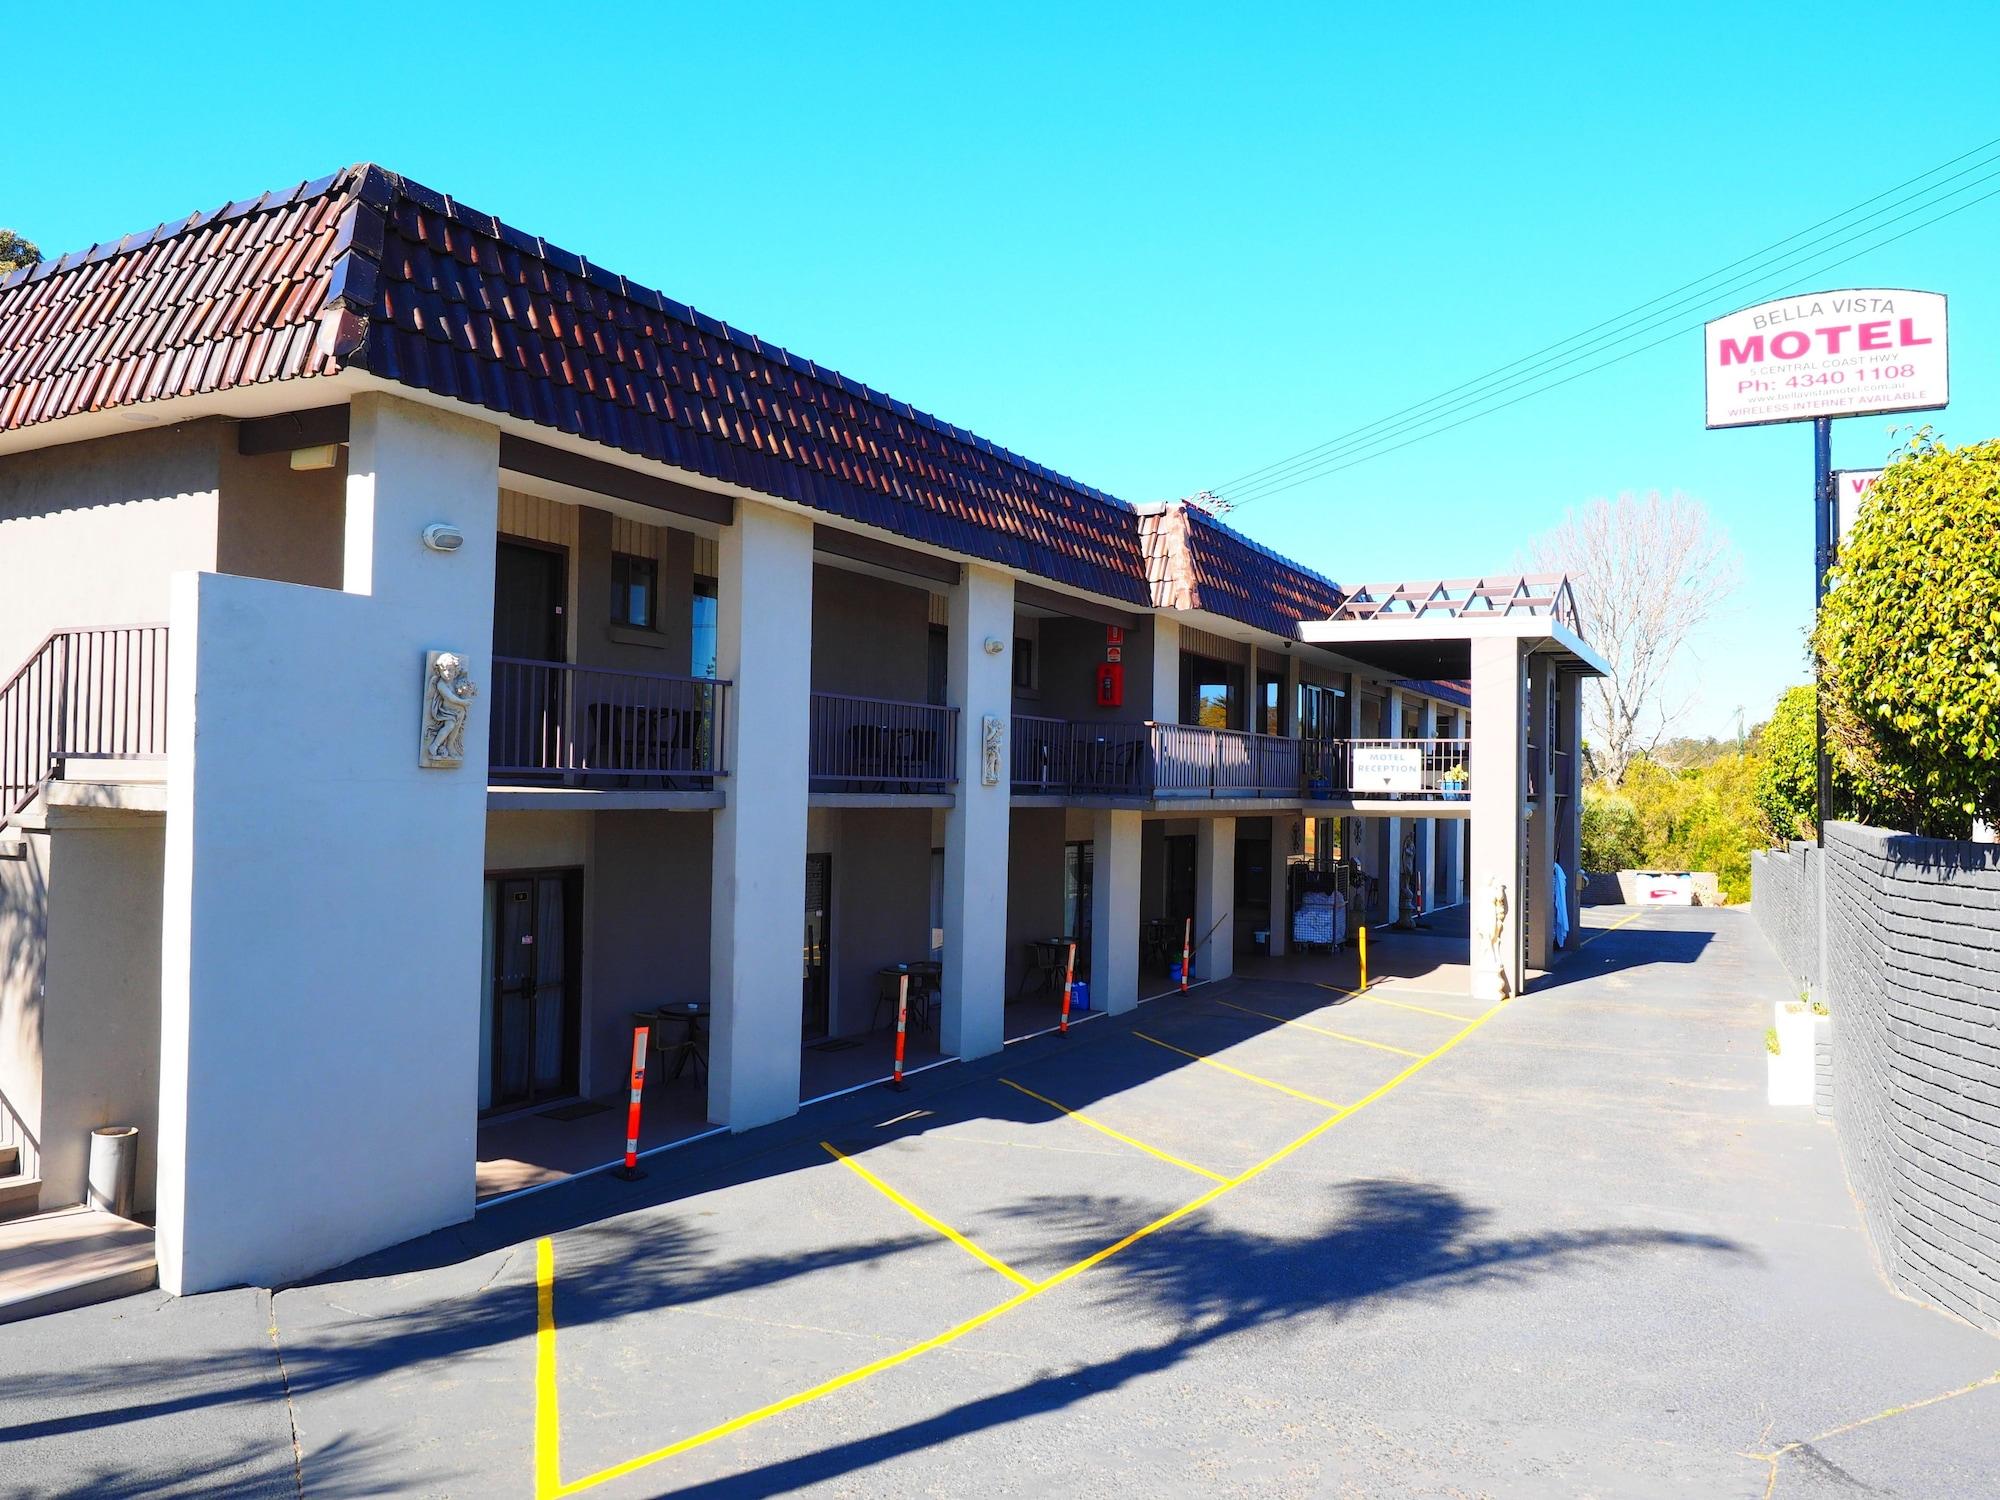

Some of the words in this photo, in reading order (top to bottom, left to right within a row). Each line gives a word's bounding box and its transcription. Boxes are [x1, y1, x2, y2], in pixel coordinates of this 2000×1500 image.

[1753, 302, 1824, 330] BELLA
[1832, 298, 1895, 314] VISTA
[1719, 318, 1932, 366] MOTEL
[1760, 361, 1818, 376] CENTRAL
[1822, 356, 1865, 368] COAST
[1870, 353, 1899, 363] HWY
[1737, 379, 1776, 394] Ph:
[1785, 370, 1845, 389] 4340
[1855, 364, 1915, 381] 1108
[1748, 382, 1905, 403] www.bellavistamotel.com.au
[1727, 403, 1790, 417] WIRELESS
[1793, 397, 1855, 410] INTERNET
[1858, 390, 1928, 404] AVAILABLE
